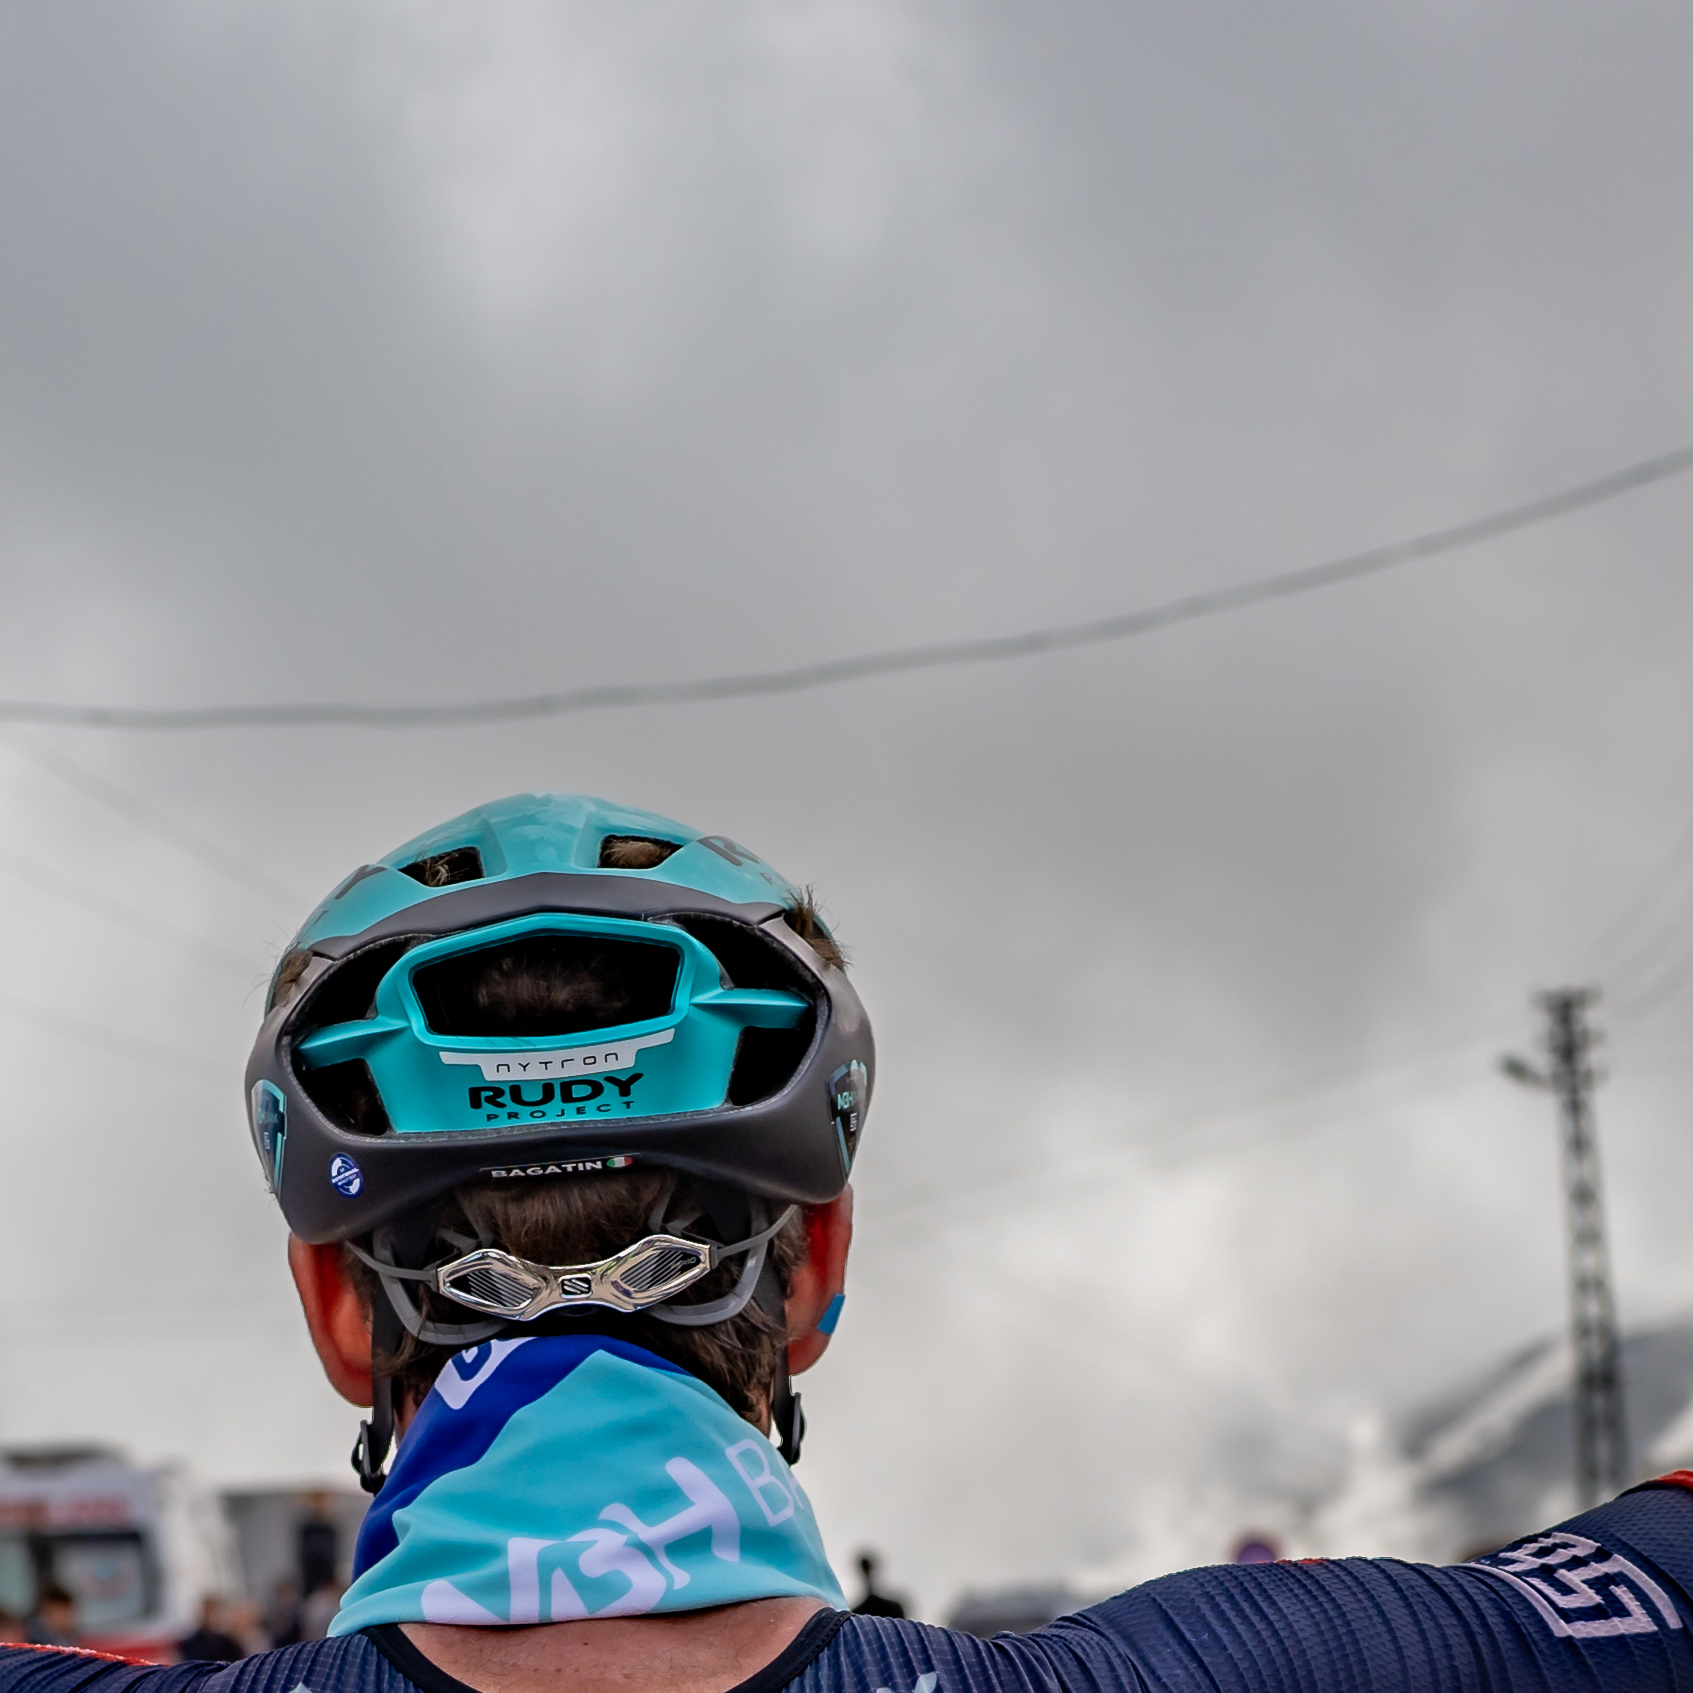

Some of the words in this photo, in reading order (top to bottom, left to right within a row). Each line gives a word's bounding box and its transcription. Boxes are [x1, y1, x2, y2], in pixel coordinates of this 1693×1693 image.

[468, 1072, 644, 1110] RUDY
[486, 1100, 635, 1122] PROJECT
[491, 1160, 603, 1178] BAGATIN
